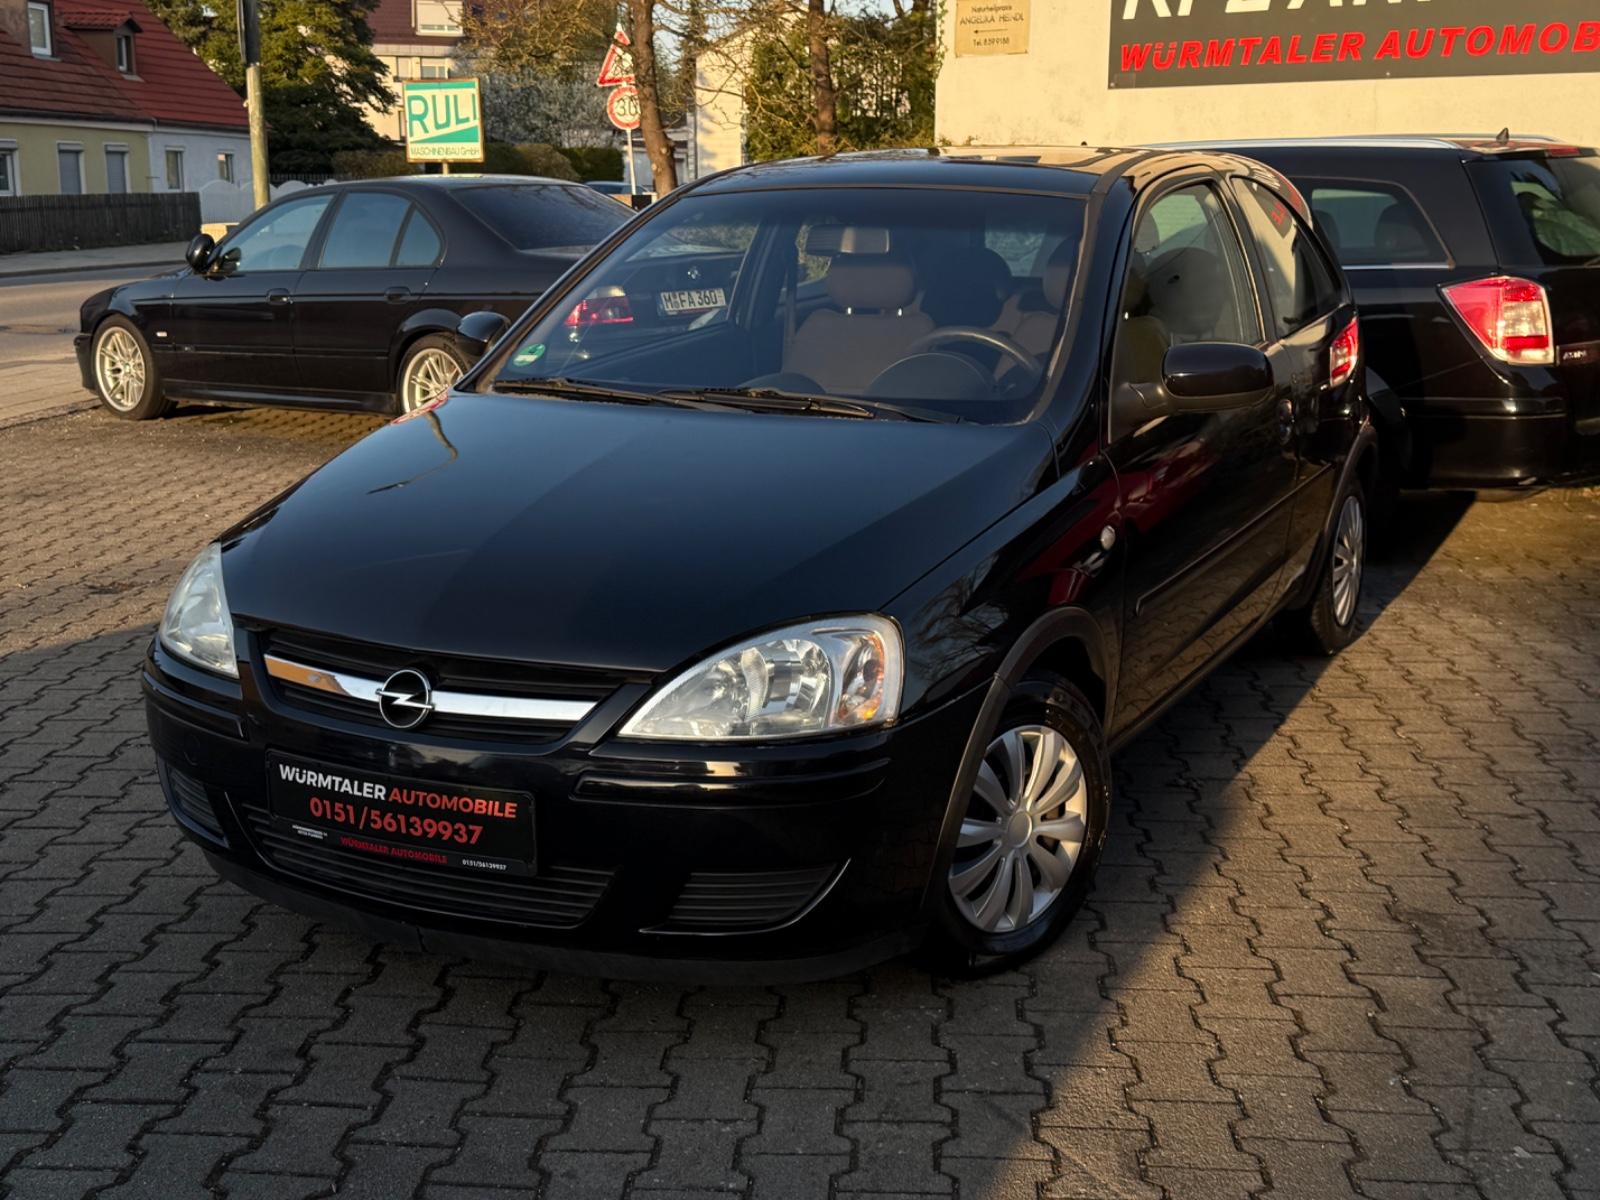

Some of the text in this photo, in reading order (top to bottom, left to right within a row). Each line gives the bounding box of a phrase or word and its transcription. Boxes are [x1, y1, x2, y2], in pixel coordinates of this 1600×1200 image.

[1120, 20, 1600, 72] WÜRMTALER AUTOMOB
[407, 93, 477, 138] RULI
[615, 95, 639, 117] 30
[278, 763, 518, 819] WÜRMTALER AUTOMOBILE
[391, 847, 448, 865] AUTOMOBILE
